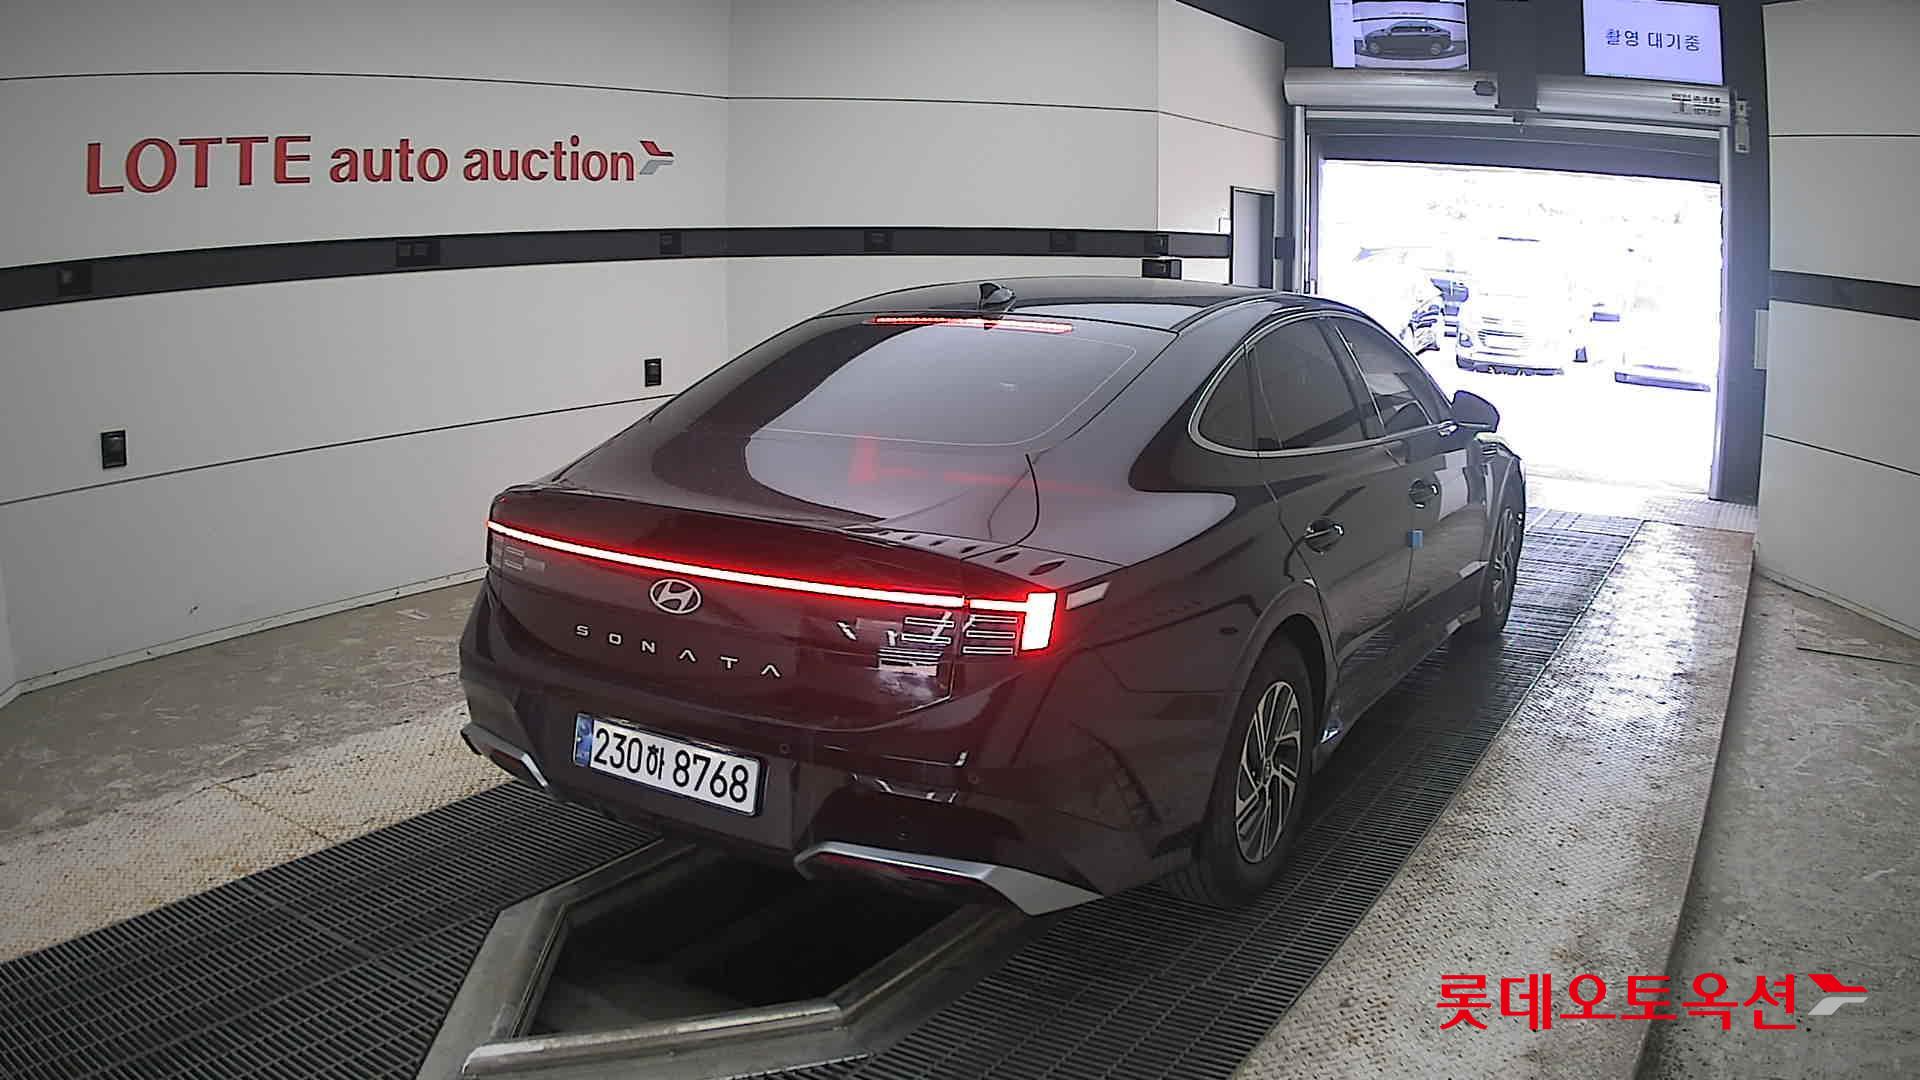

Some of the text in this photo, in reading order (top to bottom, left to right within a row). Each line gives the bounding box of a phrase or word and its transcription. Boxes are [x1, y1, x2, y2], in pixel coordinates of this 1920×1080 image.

[86, 135, 634, 194] LOTTE auto auction
[575, 624, 781, 679] SONATA
[593, 727, 749, 803] 230하 8768
